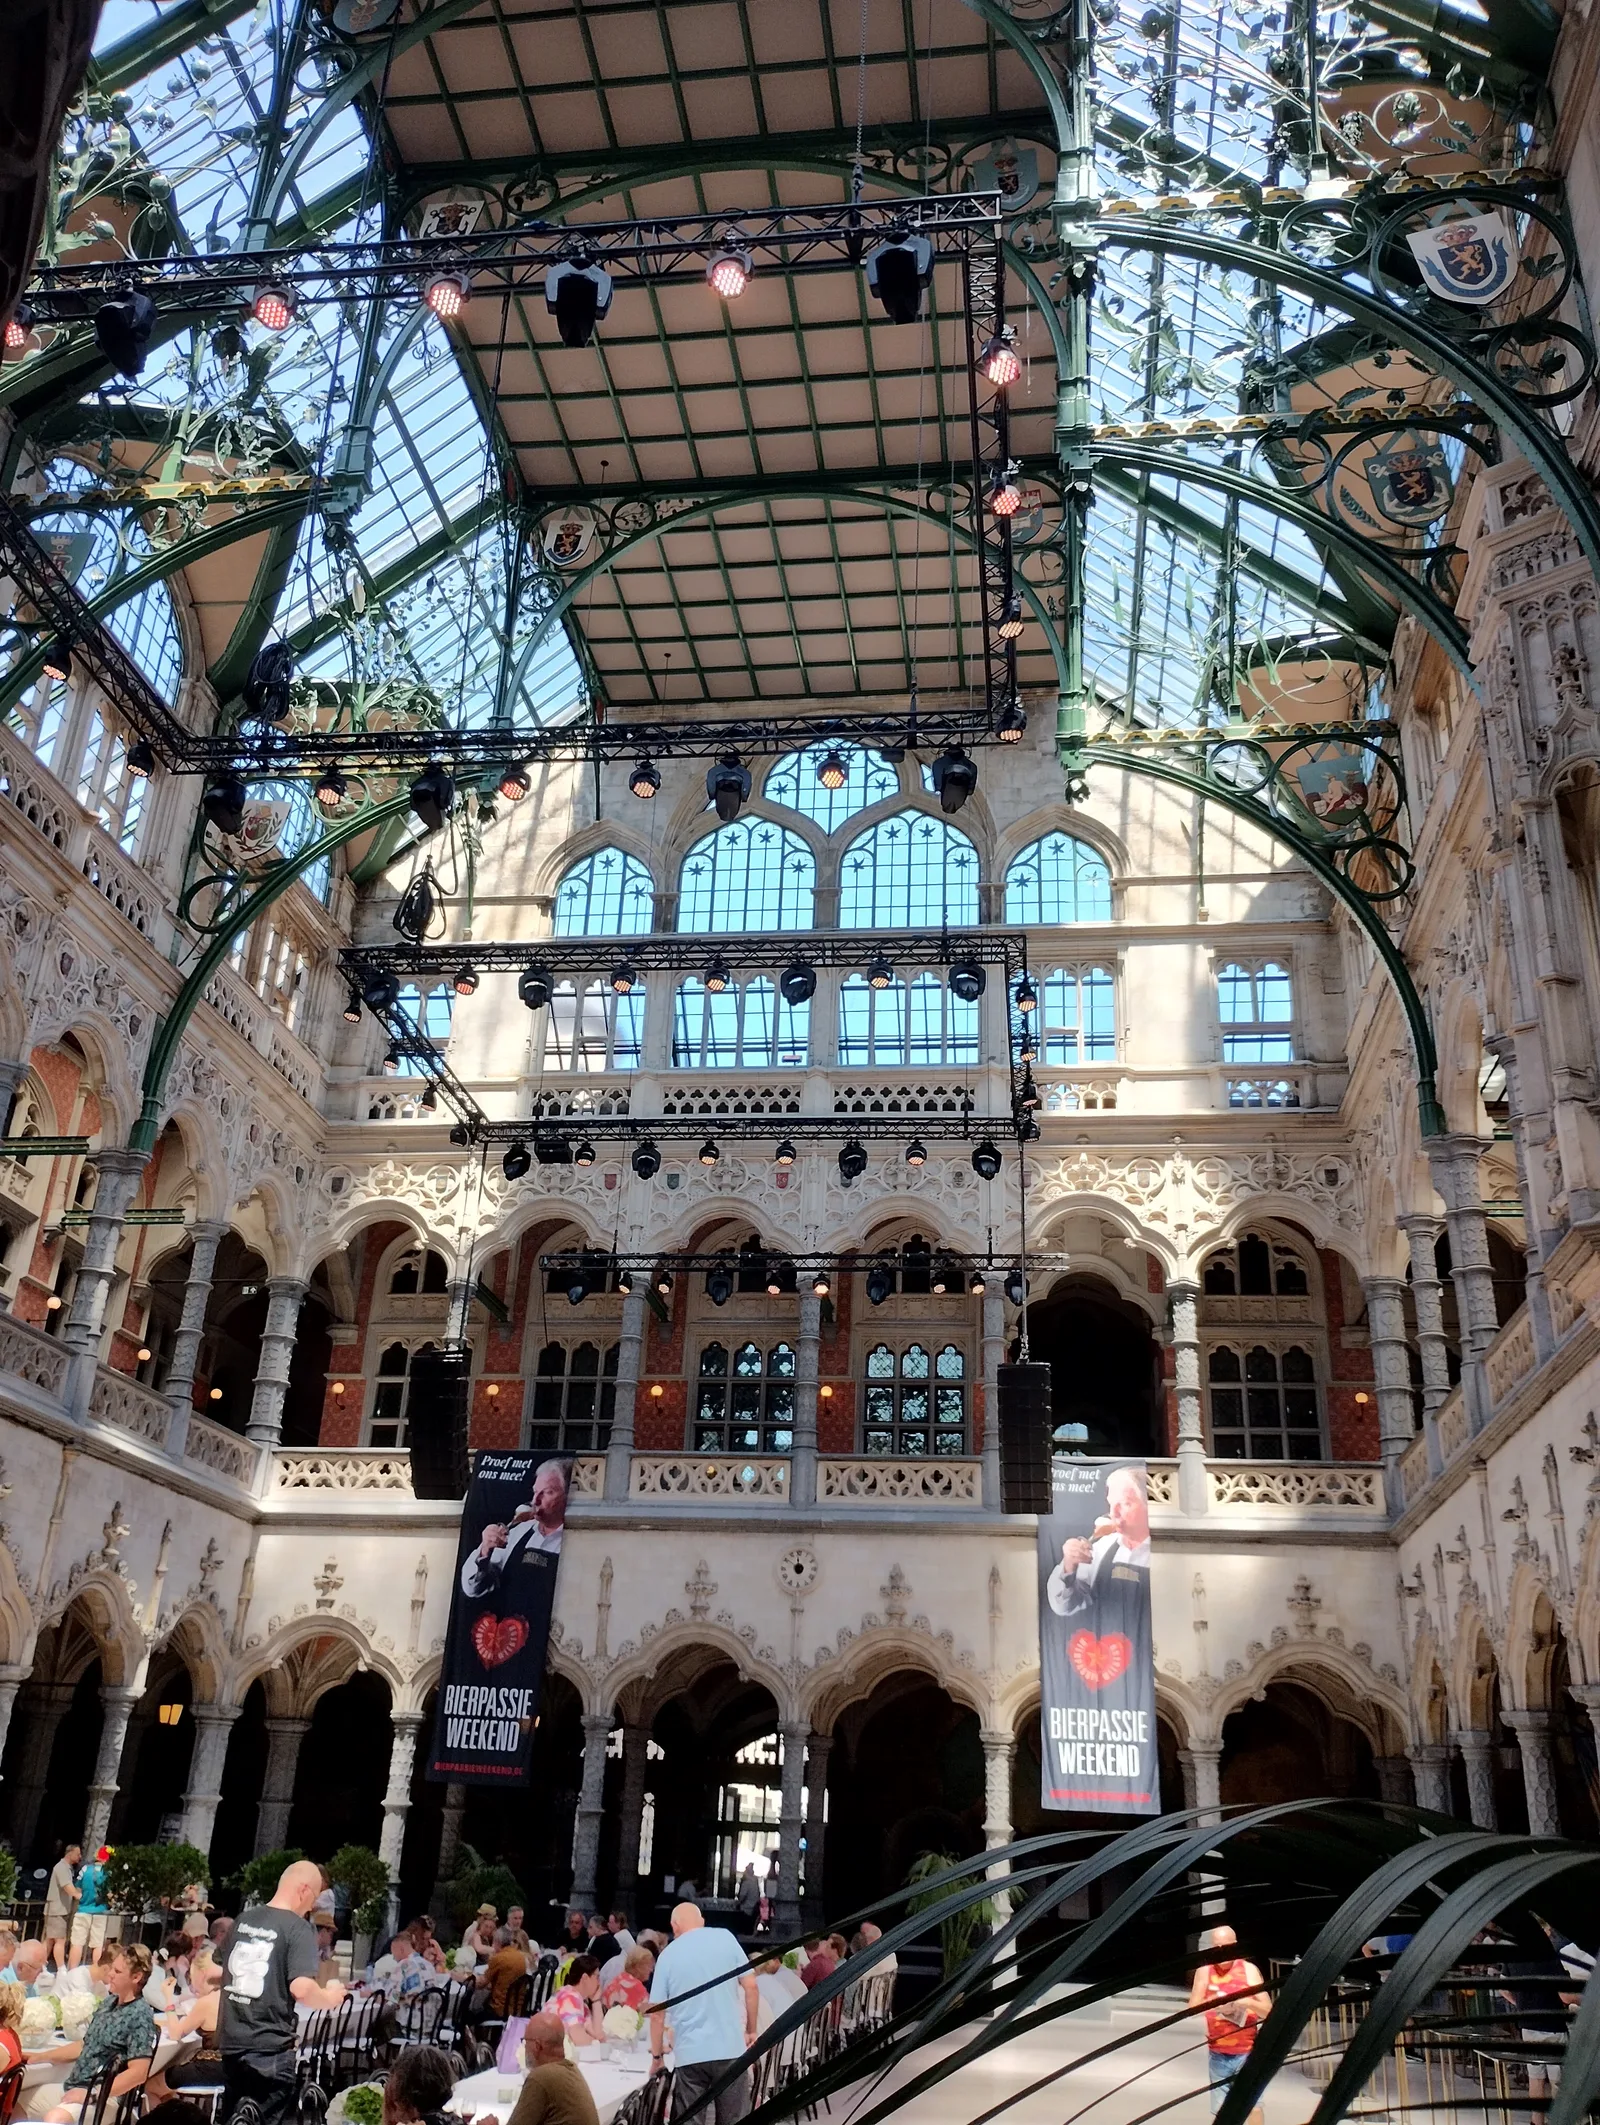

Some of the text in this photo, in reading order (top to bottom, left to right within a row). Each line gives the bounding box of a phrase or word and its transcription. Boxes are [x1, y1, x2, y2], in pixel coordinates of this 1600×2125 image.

[481, 1455, 533, 1469] Proef met
[1051, 1467, 1100, 1480] roef met
[478, 1470, 526, 1481] ons mee!
[1052, 1481, 1096, 1492] ns mee!
[444, 1685, 533, 1719] BIERPASSIE
[446, 1718, 520, 1752] WEEKEND
[1050, 1707, 1148, 1743] BIERPASSIE
[1058, 1742, 1140, 1777] WEEKEND
